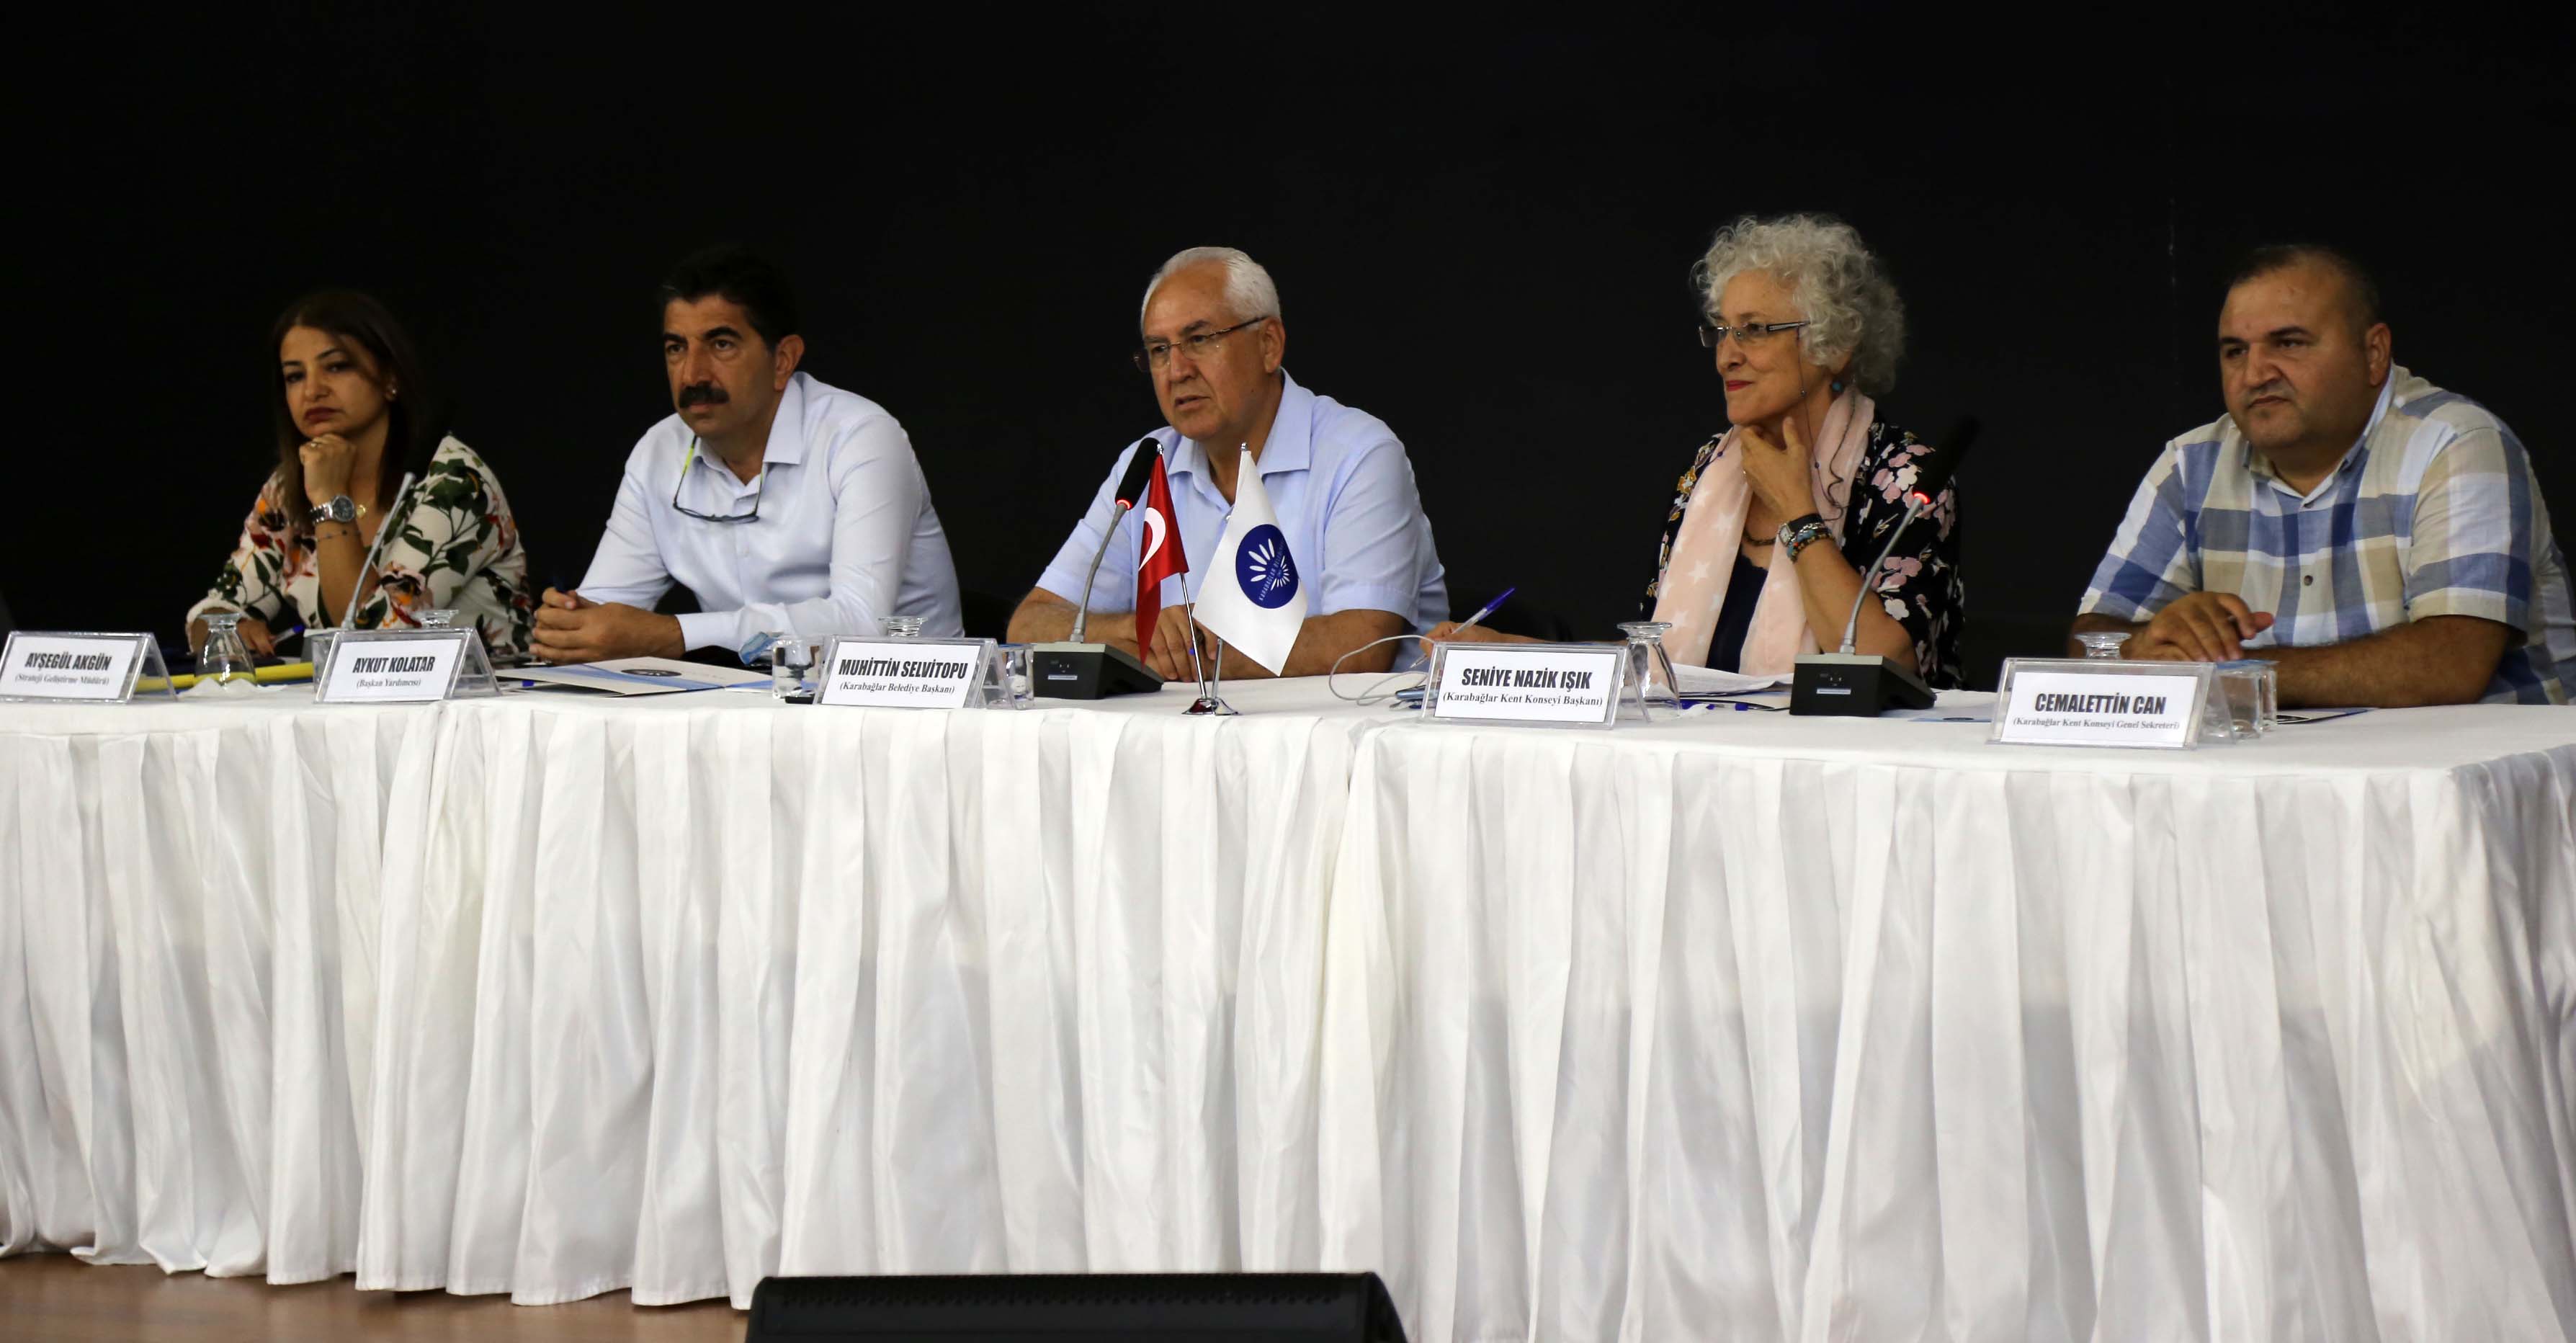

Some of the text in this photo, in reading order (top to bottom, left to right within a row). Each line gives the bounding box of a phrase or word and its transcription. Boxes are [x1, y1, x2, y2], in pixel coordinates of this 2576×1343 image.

[24, 651, 112, 671] AYŞEGÜL AKGÜN
[352, 656, 436, 674] AYKUT KOLATAR
[838, 657, 968, 679] MUHİTTİN SELVİTOPU
[357, 679, 383, 688] (Başkan
[1462, 666, 1593, 692] SENİYE NAZİK IŞIK
[840, 682, 955, 695] (Karabağlar Belediye Başkanı)
[1443, 692, 1603, 707] (Karabağlar Kent Konseyi Başkanı)
[2034, 692, 2167, 715] CEMALETTİN CAN
[2062, 718, 2083, 727] Kent
[2083, 719, 2115, 730] Konseyi
[2116, 720, 2139, 728] Genel
